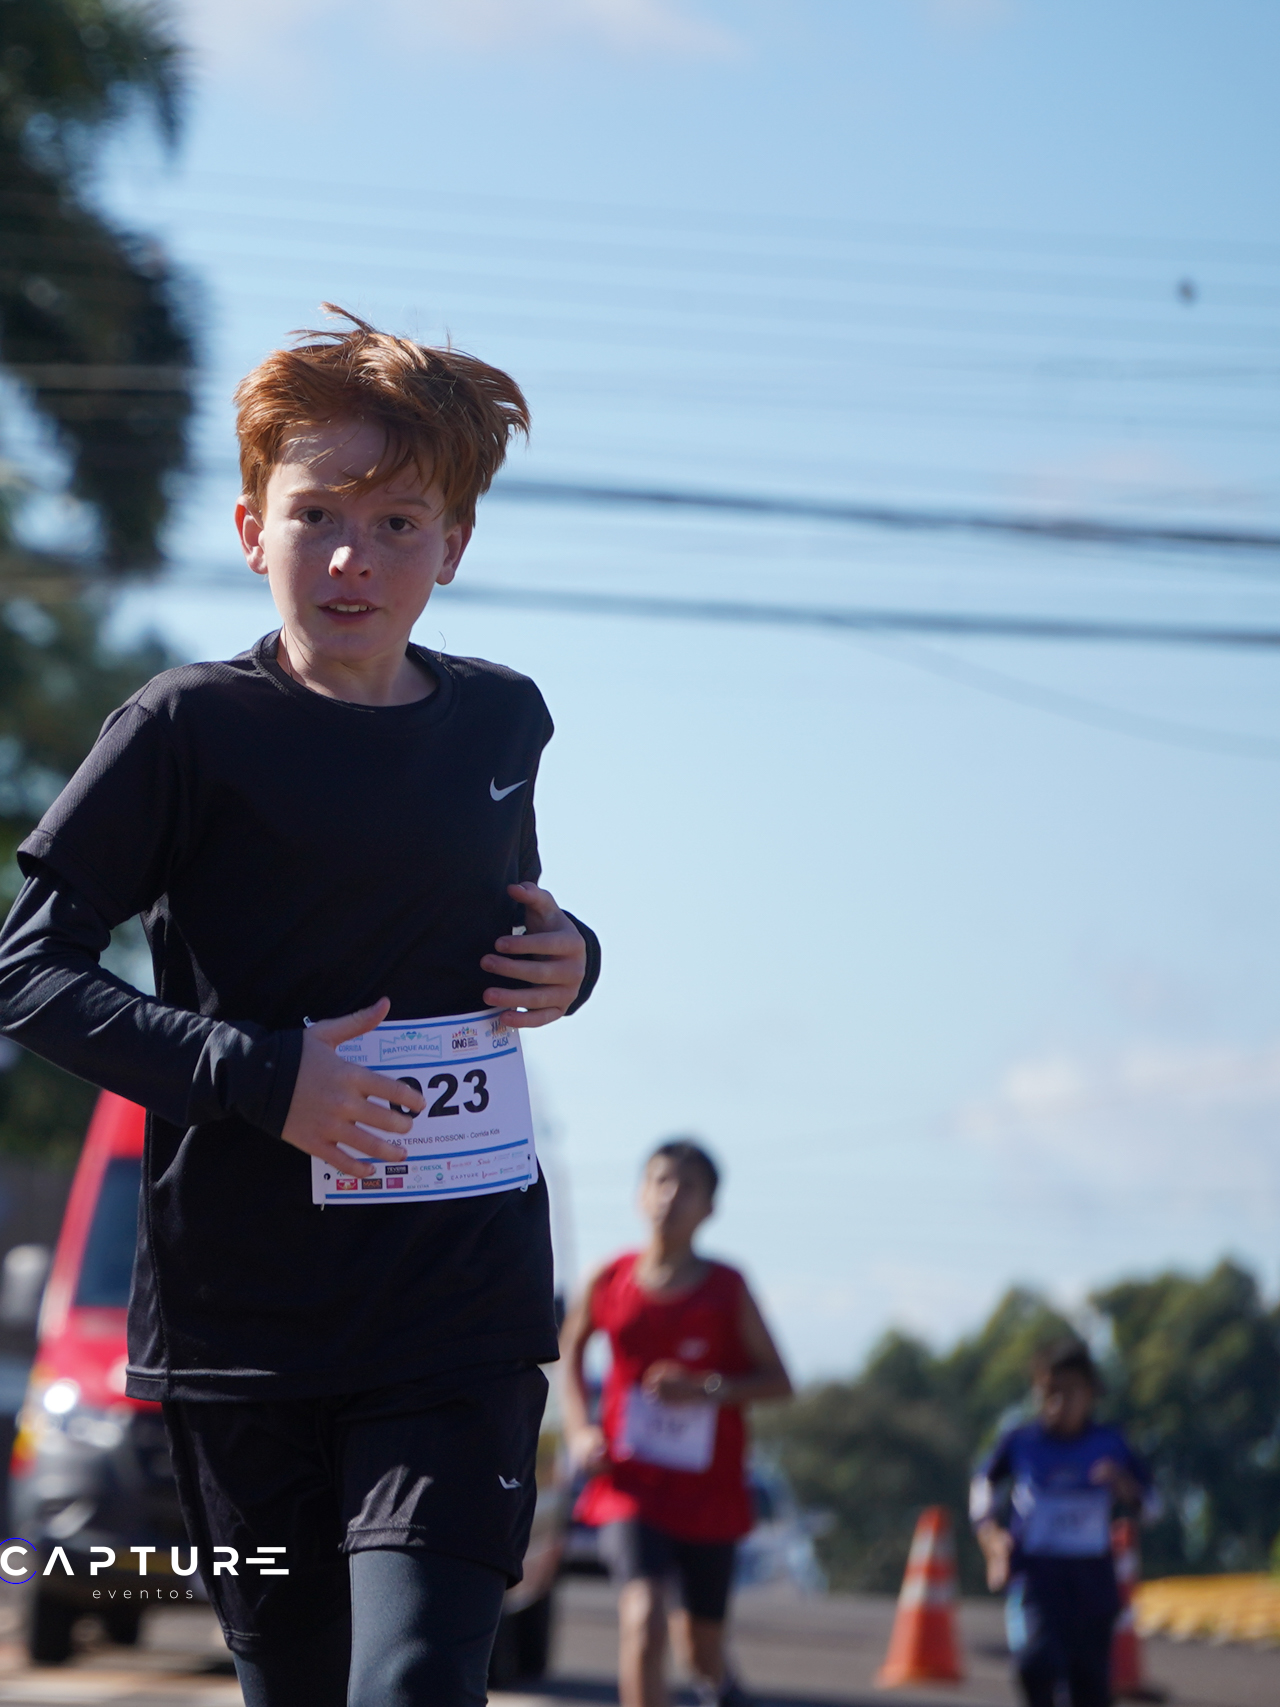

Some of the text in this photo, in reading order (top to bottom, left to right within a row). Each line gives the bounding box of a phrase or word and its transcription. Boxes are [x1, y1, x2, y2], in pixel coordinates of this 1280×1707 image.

[492, 1037, 509, 1049] CAUSA
[382, 1045, 417, 1055] PRATIQUE
[403, 1136, 433, 1145] TERNUS
[435, 1133, 466, 1143] ROSSONI
[471, 1130, 489, 1139] Corrida
[489, 1128, 500, 1136] Kids
